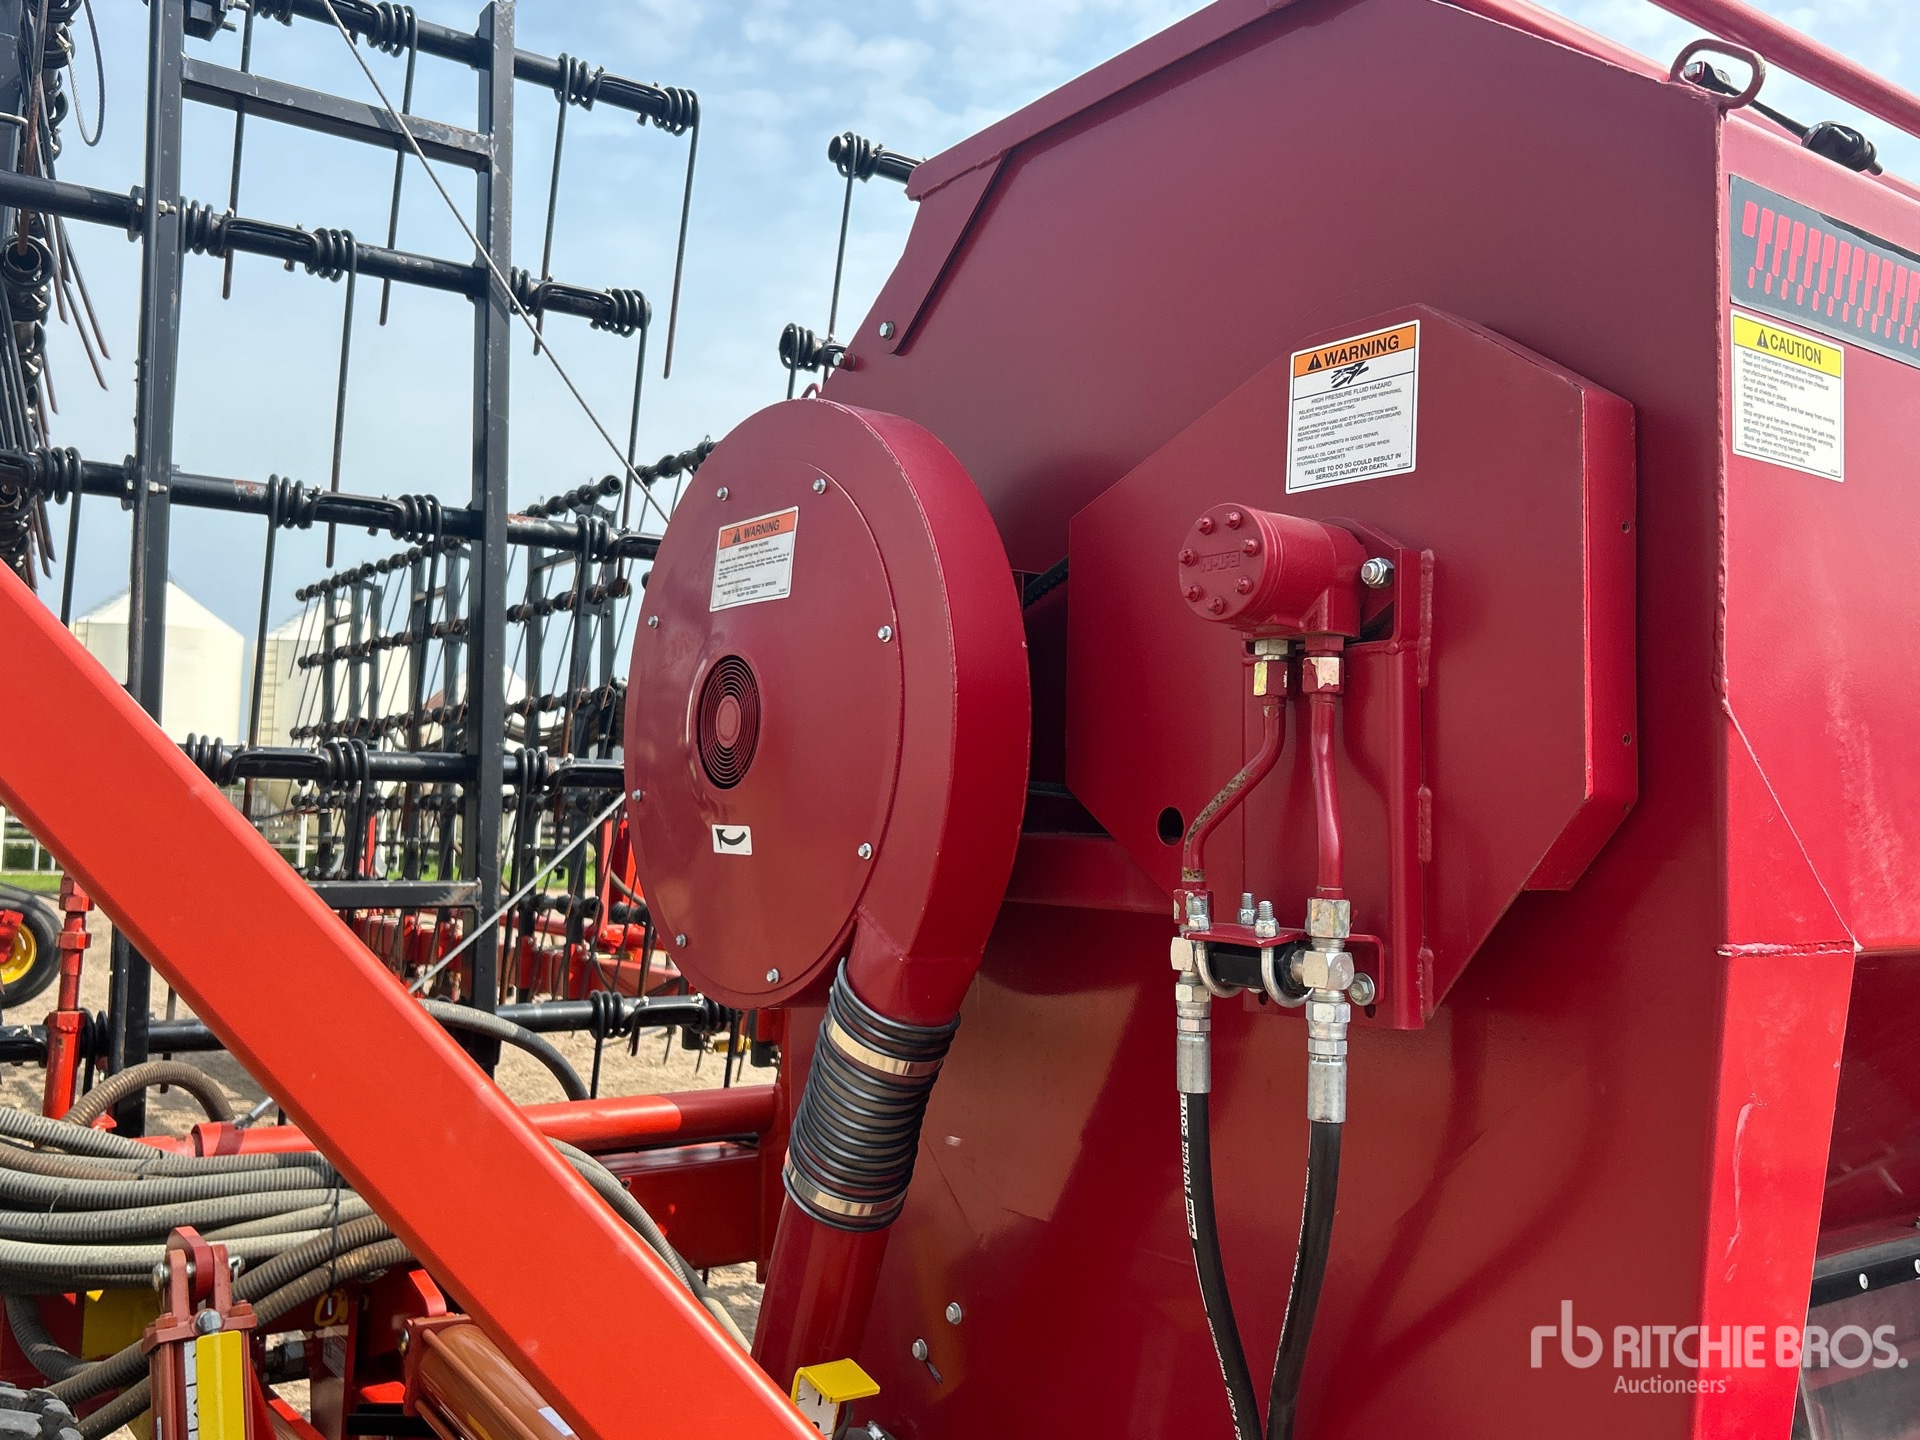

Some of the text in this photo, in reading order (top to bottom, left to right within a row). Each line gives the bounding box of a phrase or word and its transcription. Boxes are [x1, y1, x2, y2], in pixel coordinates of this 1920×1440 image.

[1324, 334, 1399, 366] WARNING
[1770, 334, 1821, 365] CAUTION
[1325, 390, 1352, 401] PRESSURE
[1354, 386, 1368, 395] FLUID
[1370, 381, 1392, 391] HAZARD
[1305, 467, 1325, 476] FAILURE
[1353, 458, 1372, 467] COULD
[1373, 454, 1393, 463] RESULT
[1316, 471, 1338, 480] SERIOUS
[1340, 467, 1358, 476] INJURY
[744, 520, 780, 538] WARNING
